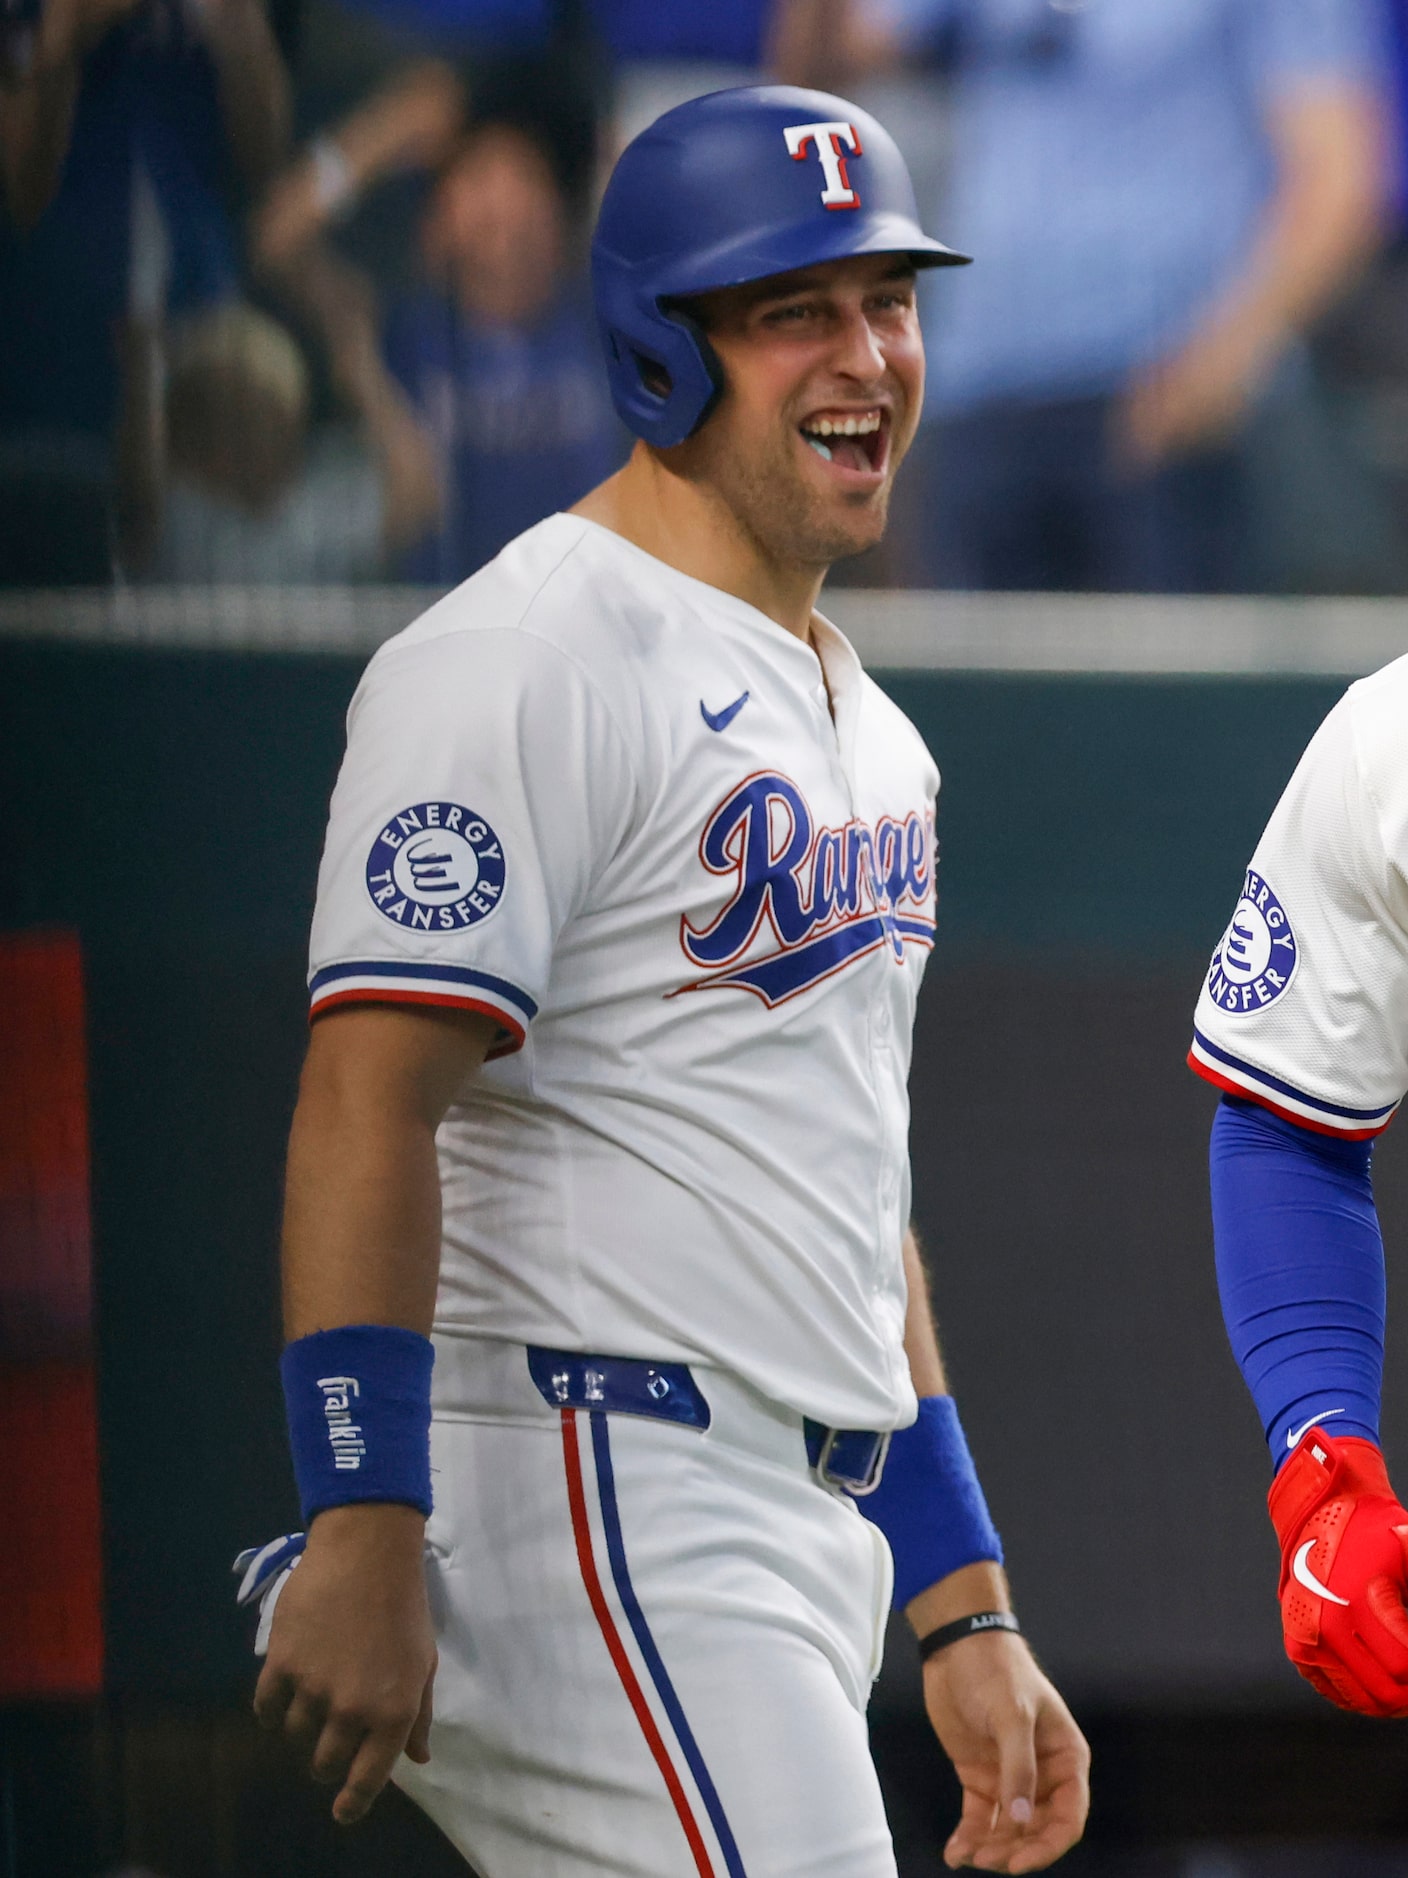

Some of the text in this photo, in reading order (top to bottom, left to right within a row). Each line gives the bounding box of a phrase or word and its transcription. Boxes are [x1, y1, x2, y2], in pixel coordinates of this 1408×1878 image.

[783, 122, 863, 210] T
[380, 804, 502, 860] ENERGY
[369, 869, 501, 930] TRANSFER
[663, 769, 937, 1009] Range
[316, 1376, 367, 1470] Franklin
